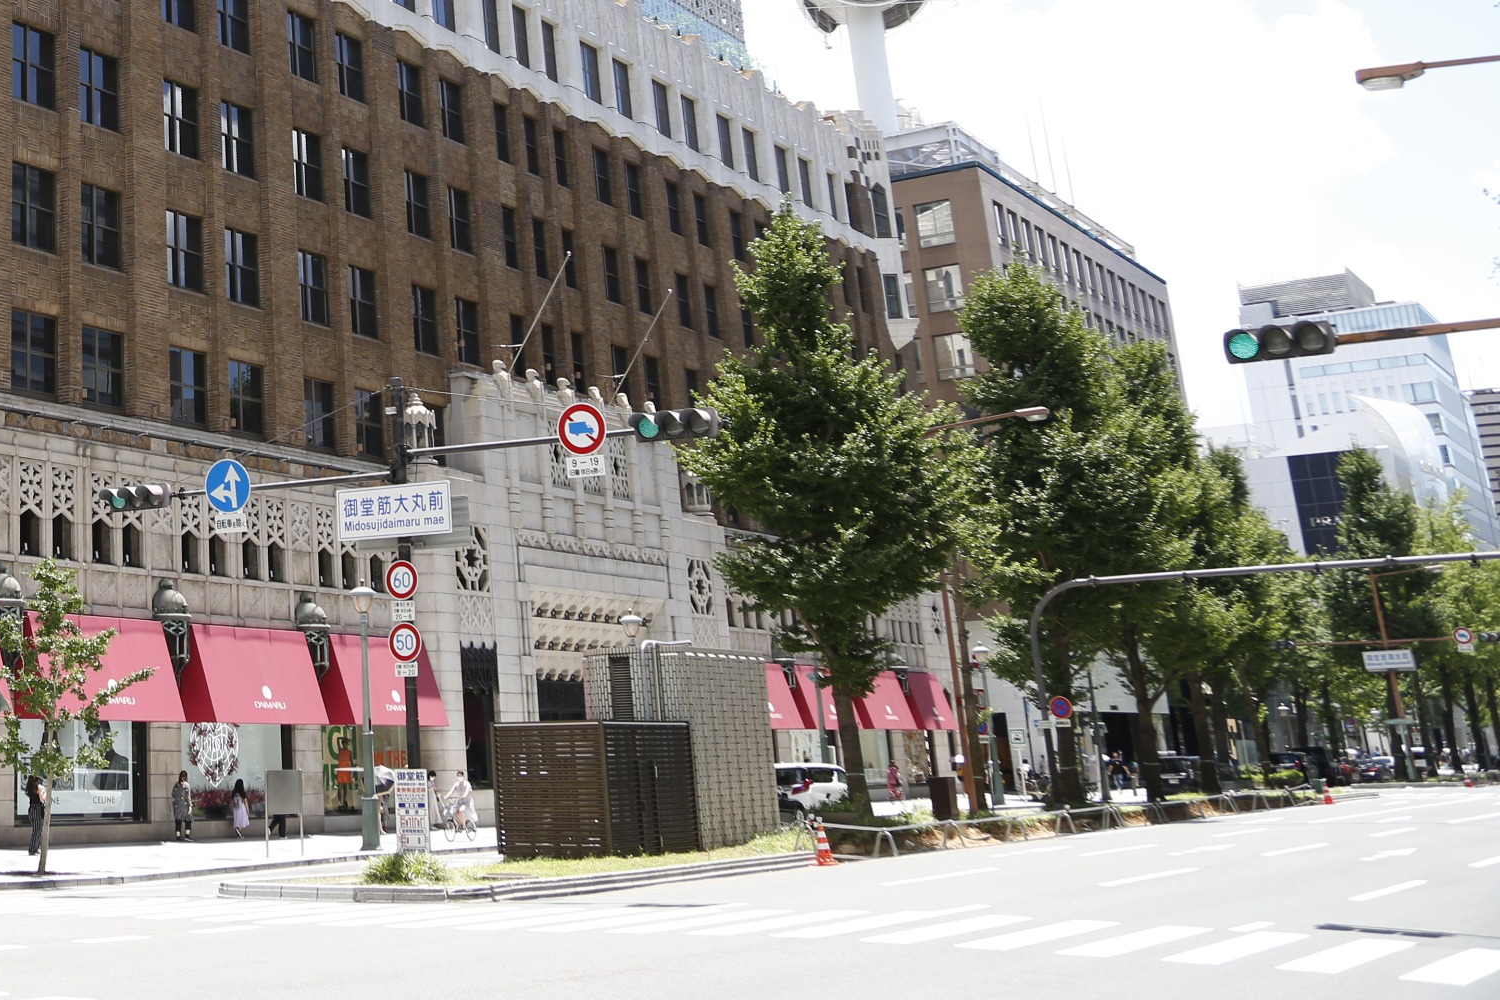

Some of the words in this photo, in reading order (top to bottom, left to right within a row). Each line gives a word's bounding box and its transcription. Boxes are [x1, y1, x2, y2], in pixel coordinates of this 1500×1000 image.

[343, 490, 444, 519] 御堂筋大丸前
[344, 518, 421, 533] Midosujidaimaru
[424, 515, 445, 527] mae
[393, 571, 411, 589] 60
[396, 633, 414, 651] 50
[254, 700, 286, 709] DAIMARU
[397, 771, 425, 782] 御堂筋
[92, 796, 116, 804] CELINE
